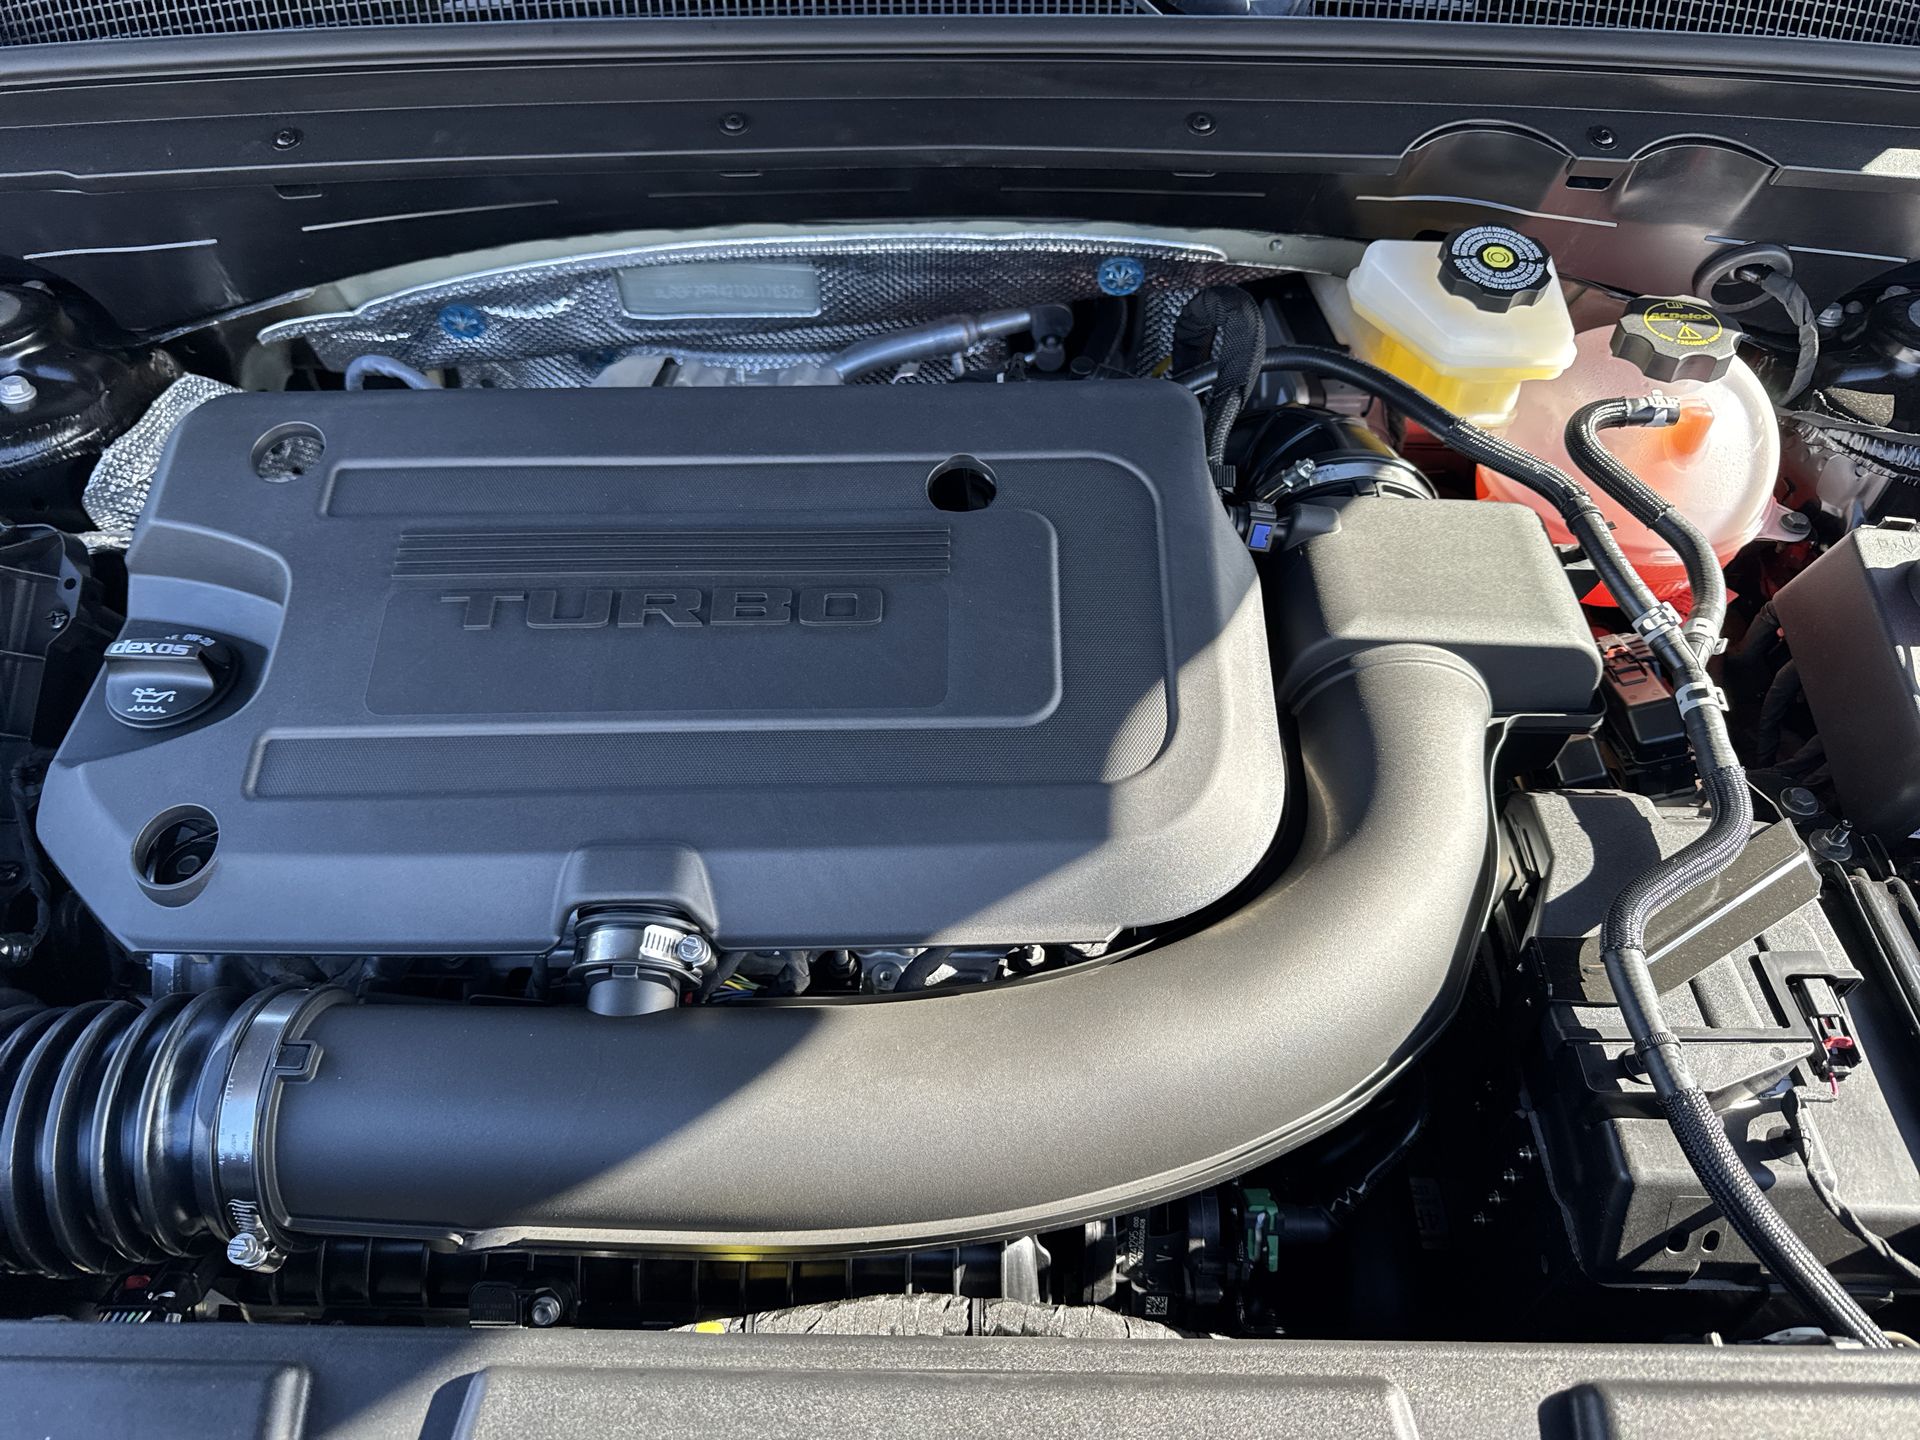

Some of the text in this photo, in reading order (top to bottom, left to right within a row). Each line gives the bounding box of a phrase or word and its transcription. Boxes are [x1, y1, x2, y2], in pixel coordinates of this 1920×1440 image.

[1462, 270, 1481, 283] FLUID
[1478, 279, 1497, 289] FROM
[1503, 281, 1528, 290] SEALED
[1467, 266, 1490, 281] BEFORE
[1650, 312, 1712, 320] ACDelco
[440, 587, 884, 630] TURBO
[110, 639, 193, 655] dexos
